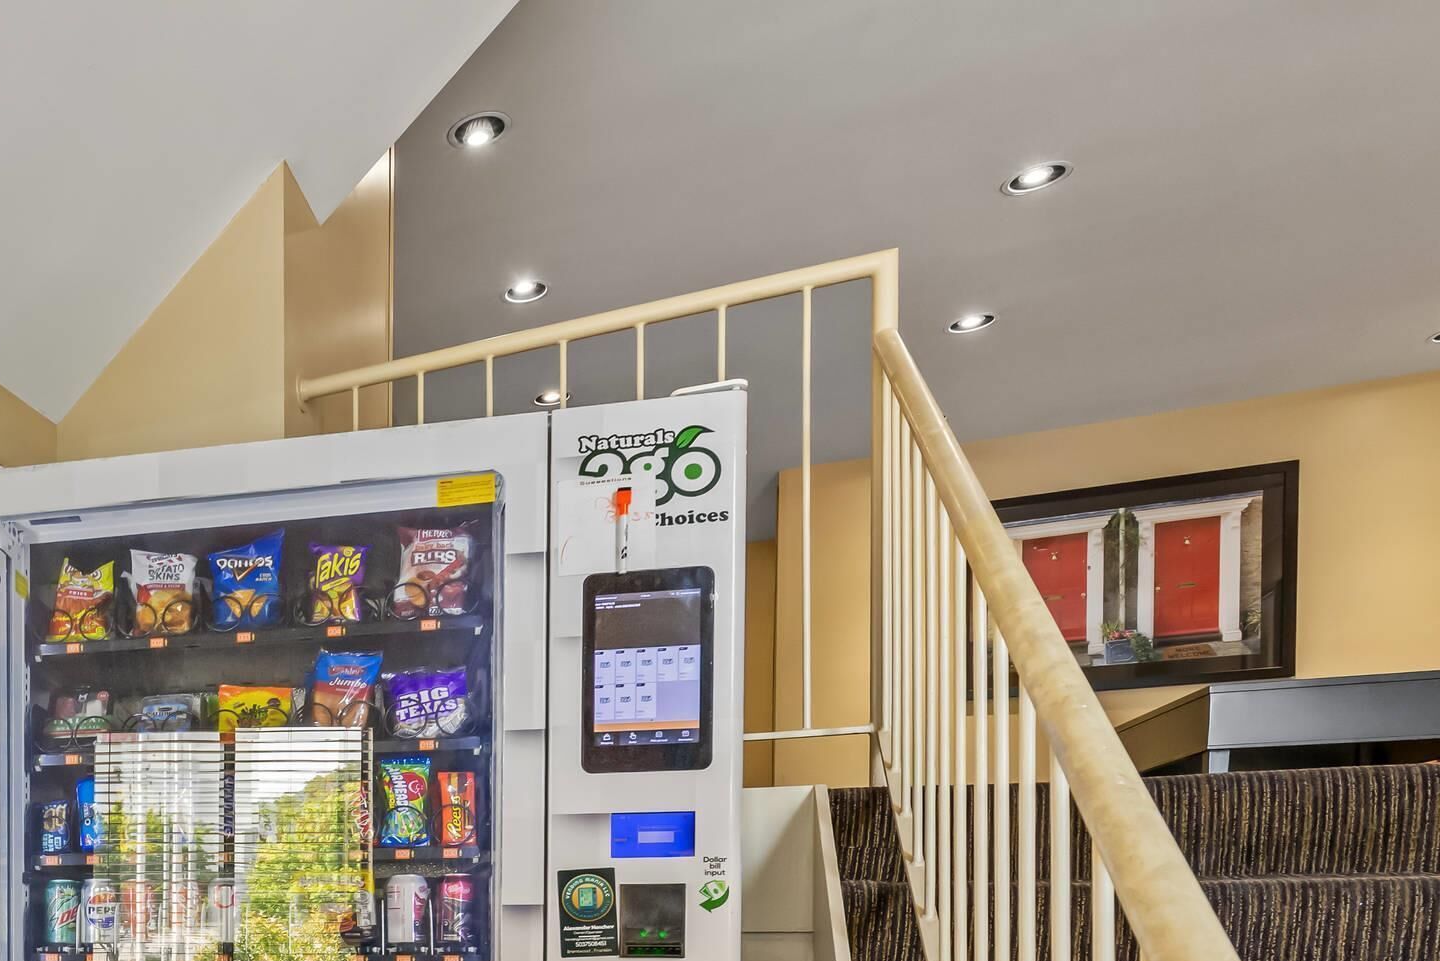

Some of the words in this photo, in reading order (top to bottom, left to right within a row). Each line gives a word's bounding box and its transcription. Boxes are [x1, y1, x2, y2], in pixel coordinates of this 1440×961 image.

[578, 428, 676, 453] Naturals
[656, 510, 729, 526] hoices
[316, 546, 362, 589] Takis
[148, 573, 181, 581] SKINS
[328, 677, 368, 689] Jumbo
[400, 687, 449, 708] BIG
[395, 699, 458, 721] TEXAS
[704, 869, 726, 877] input
